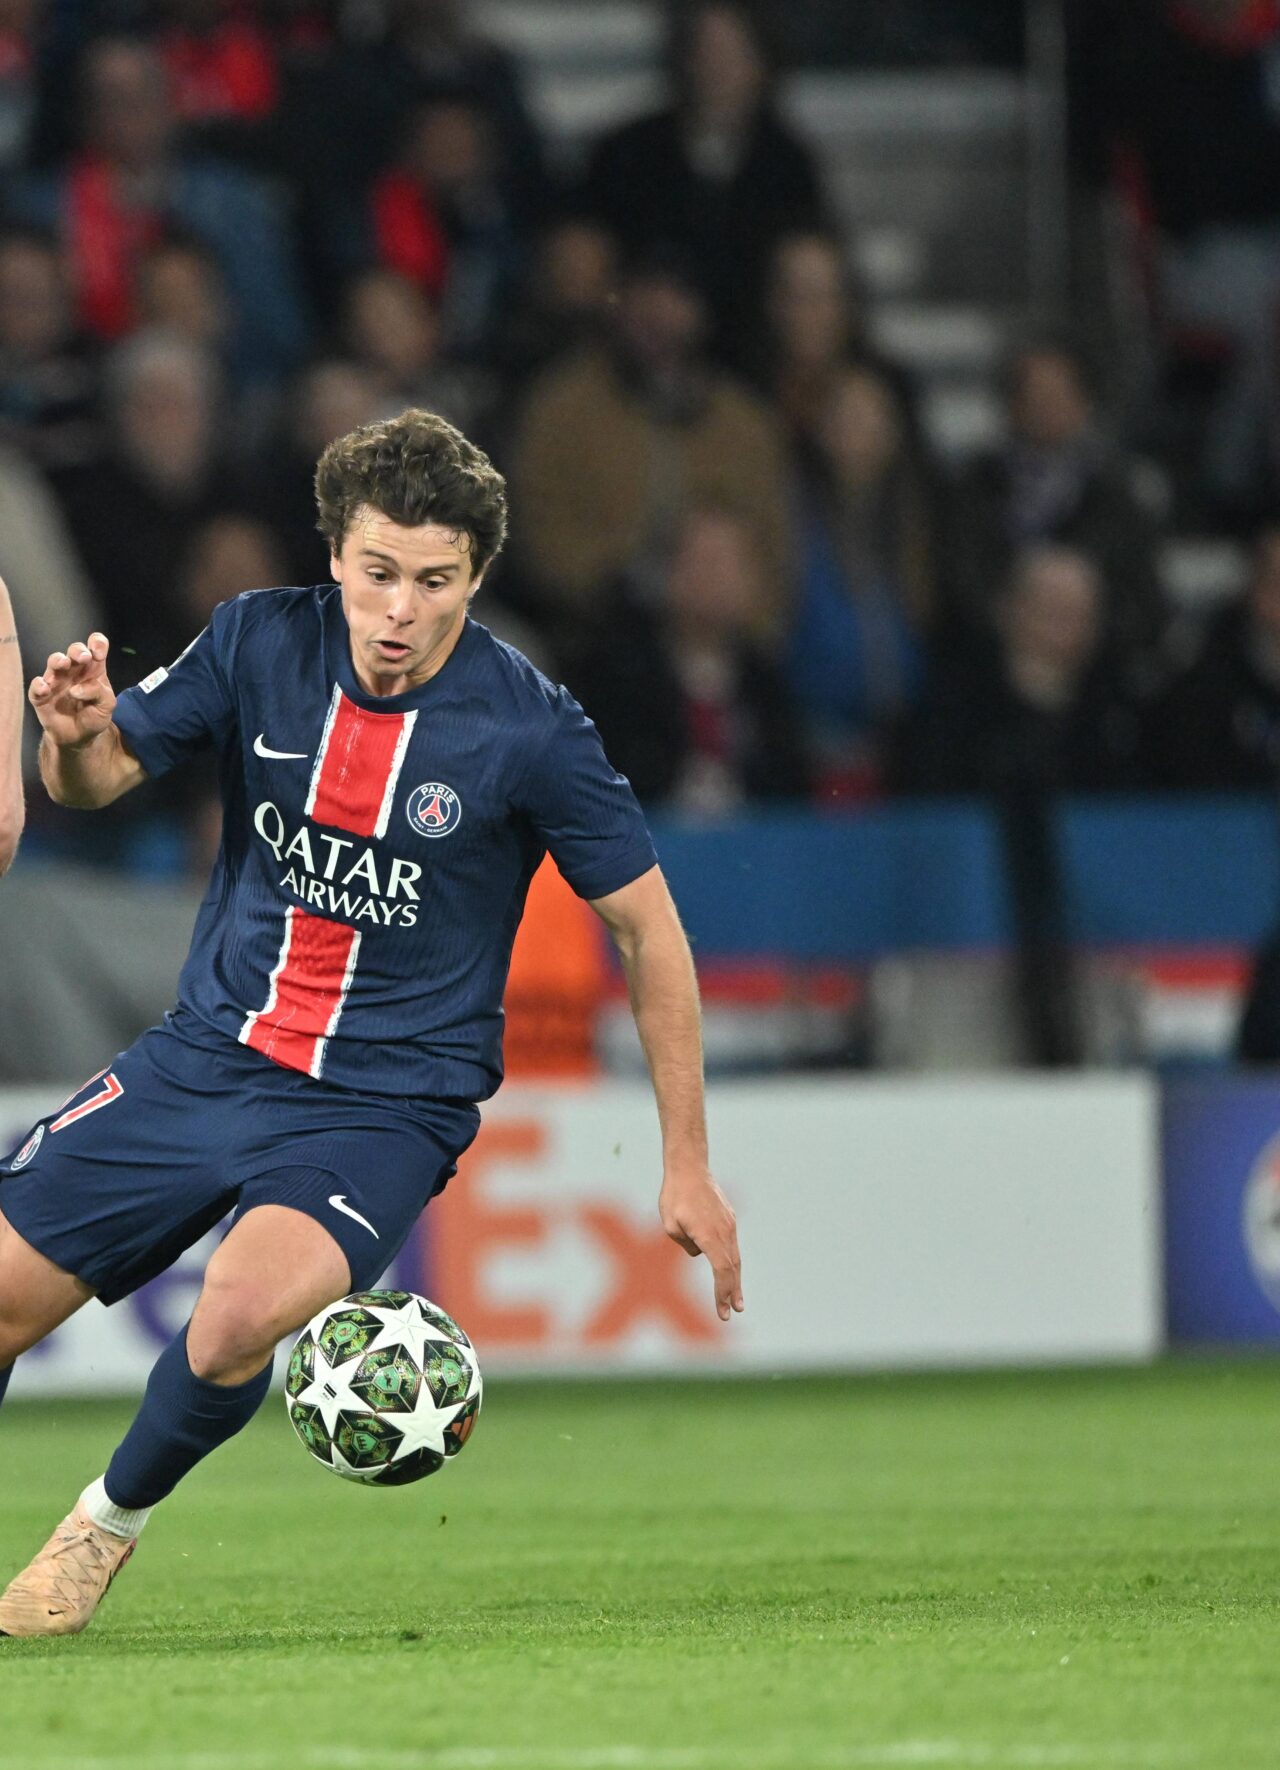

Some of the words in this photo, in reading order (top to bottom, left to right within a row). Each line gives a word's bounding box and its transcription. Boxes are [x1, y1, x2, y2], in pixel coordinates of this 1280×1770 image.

[420, 785, 456, 804] PARIS
[254, 801, 422, 900] QATAR
[279, 866, 419, 927] AIRWAYS
